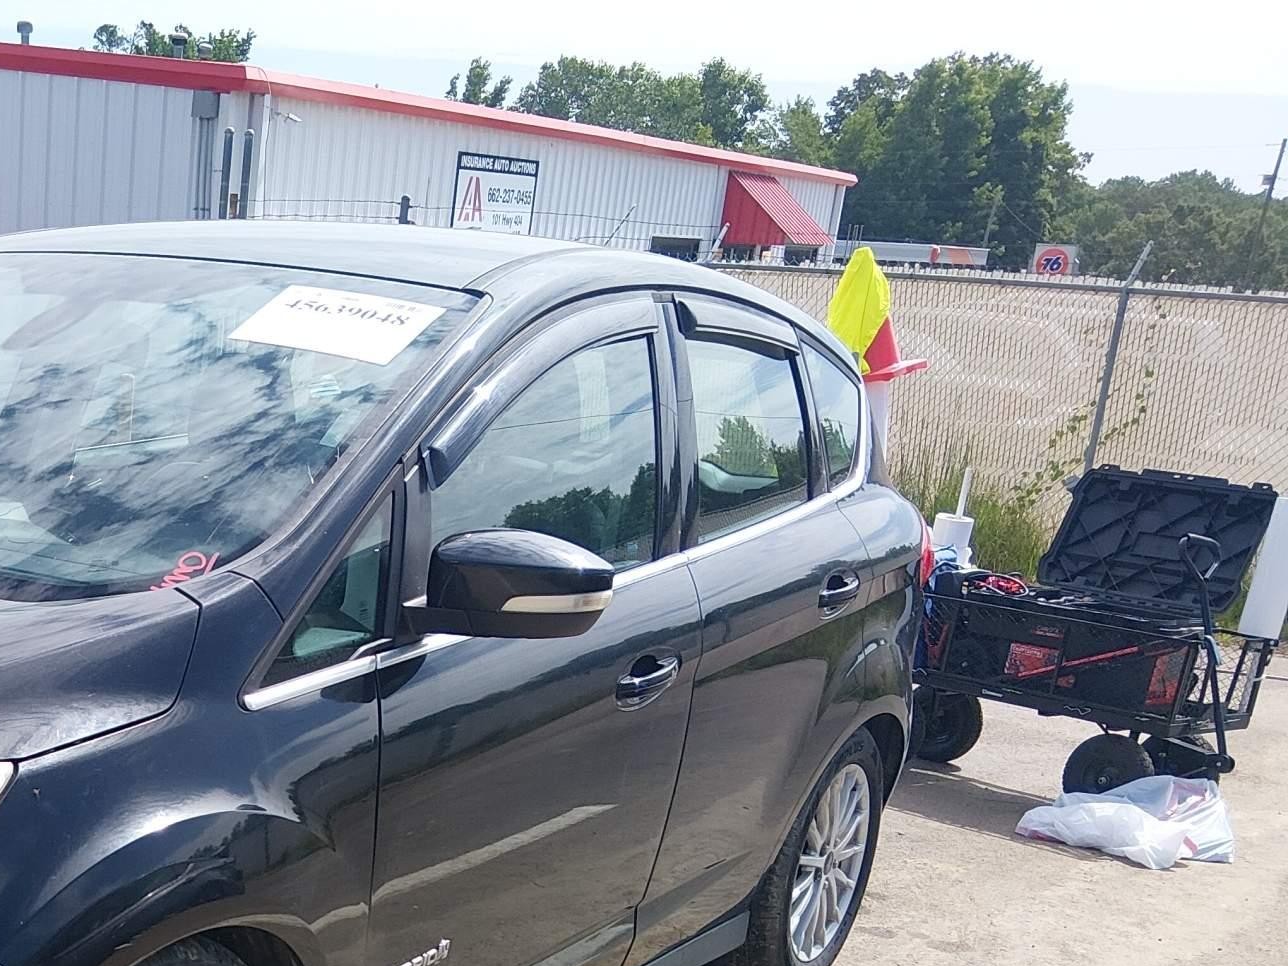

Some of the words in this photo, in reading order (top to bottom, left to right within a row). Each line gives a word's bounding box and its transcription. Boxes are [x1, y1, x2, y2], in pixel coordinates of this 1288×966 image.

[460, 155, 493, 170] INSURANCE
[494, 159, 510, 172] AUTO
[509, 160, 537, 174] AUCTIONS
[501, 213, 513, 228] Hwy
[1041, 256, 1063, 272] 76
